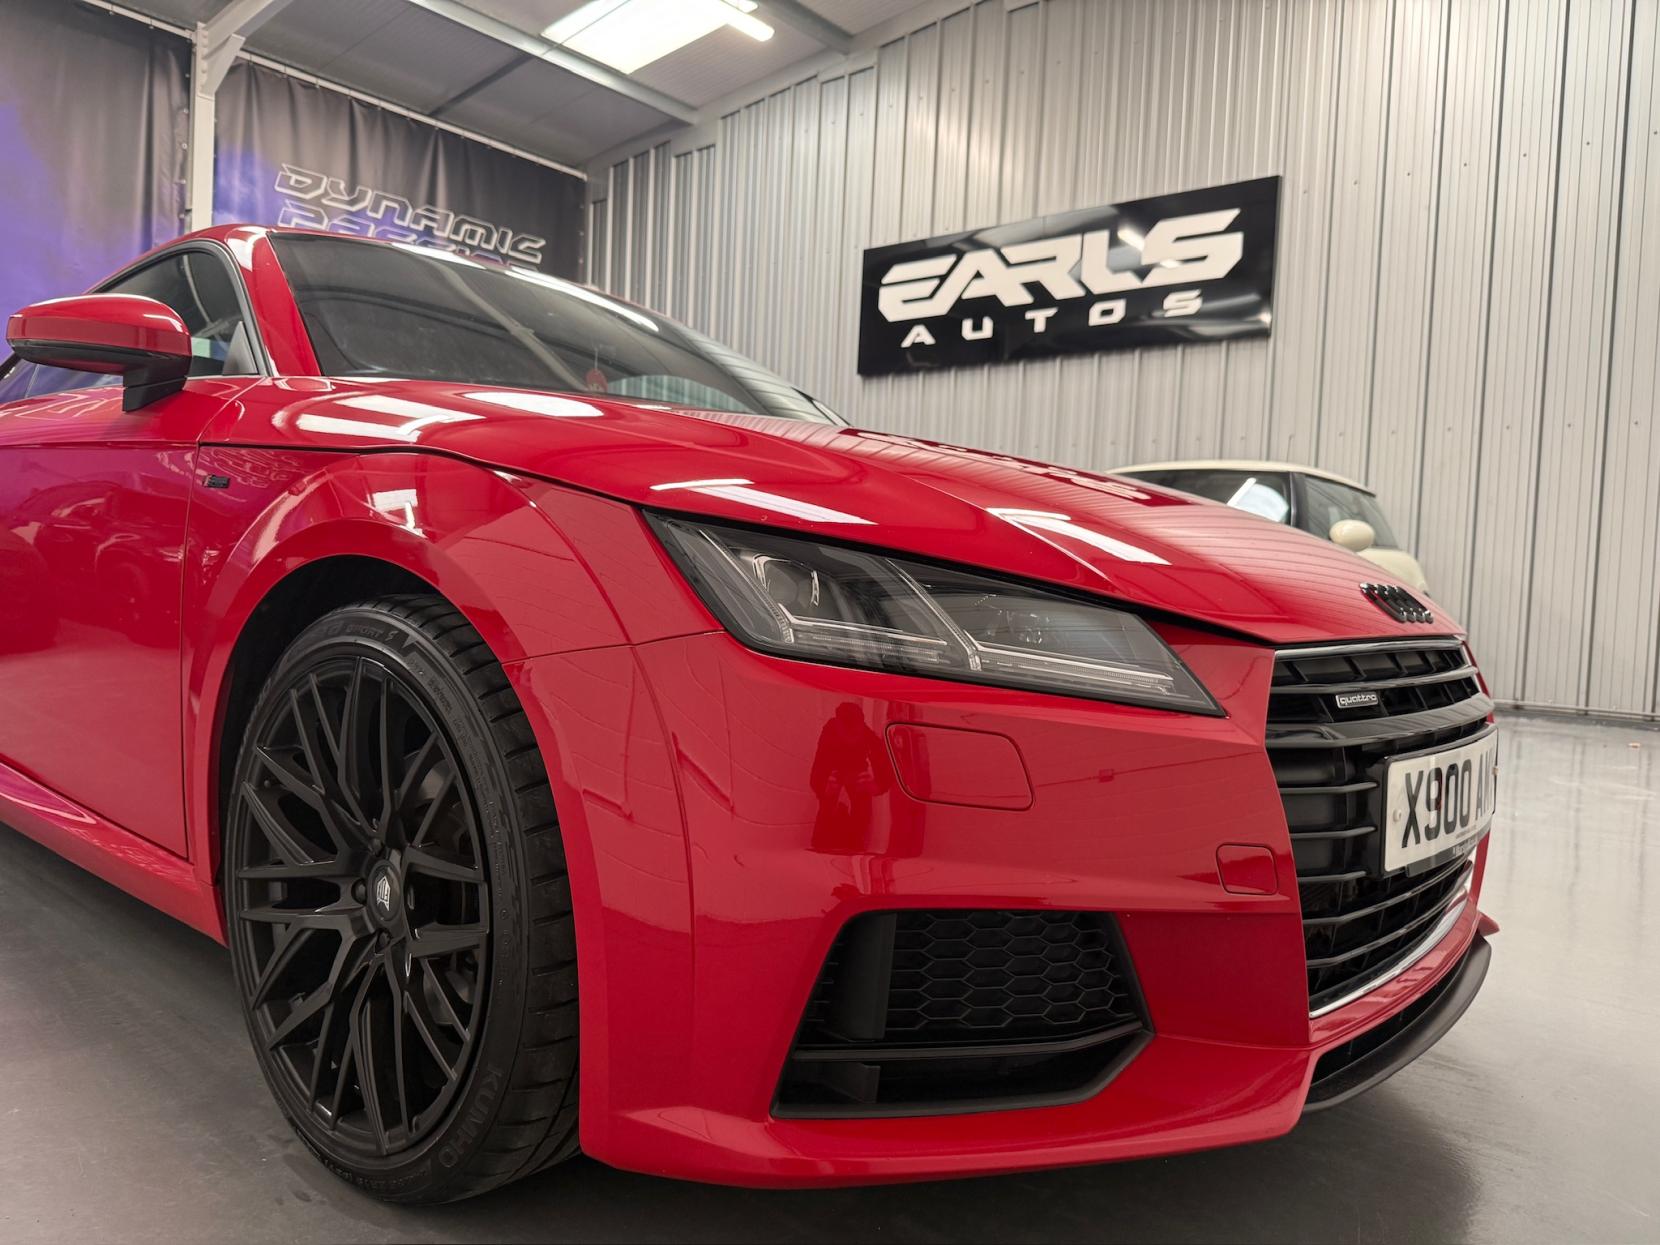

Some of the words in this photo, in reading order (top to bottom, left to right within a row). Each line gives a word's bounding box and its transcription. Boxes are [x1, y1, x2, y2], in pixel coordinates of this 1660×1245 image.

[878, 208, 1244, 323] EARLS
[901, 289, 1203, 348] AUTOS
[1339, 694, 1377, 706] quattro
[1401, 759, 1472, 848] X900
[438, 1063, 504, 1168] KUMHO
